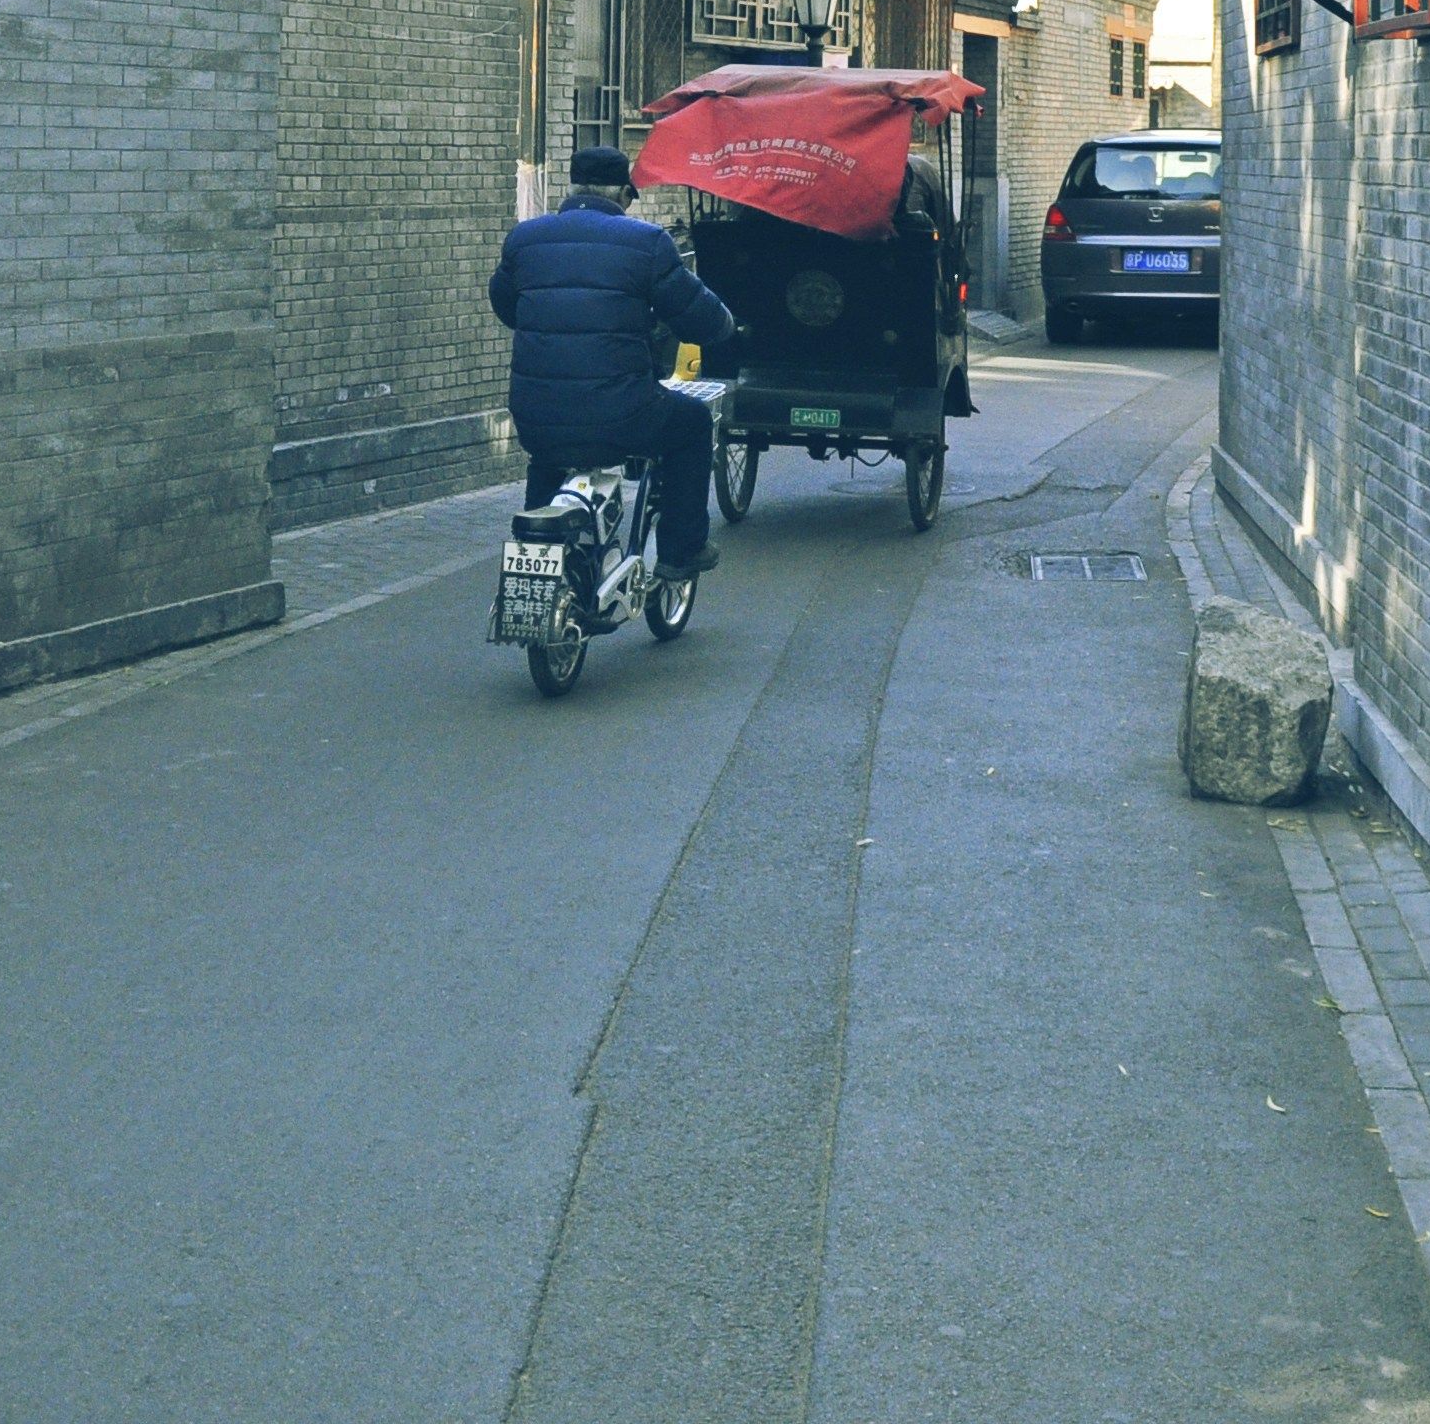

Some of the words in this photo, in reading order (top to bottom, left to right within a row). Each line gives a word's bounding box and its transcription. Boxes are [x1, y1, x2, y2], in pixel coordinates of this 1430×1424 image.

[507, 557, 559, 574] 785077
[503, 577, 556, 602] 爱玛专卖
